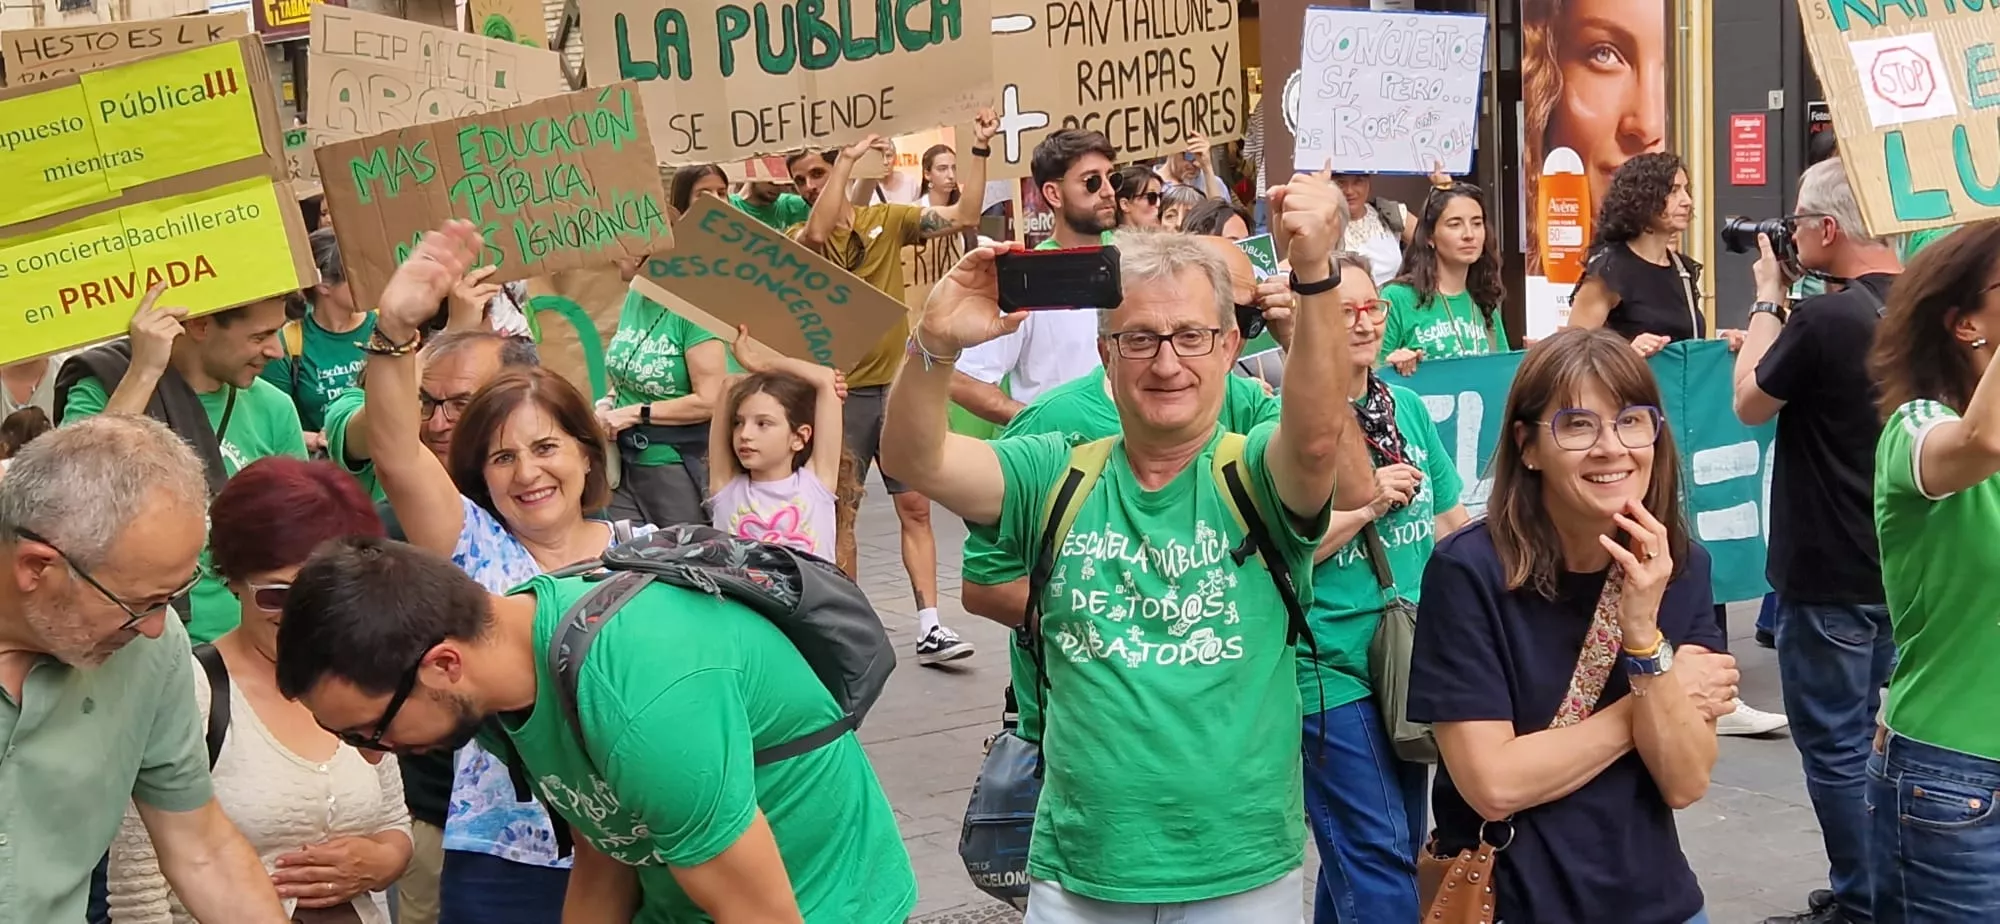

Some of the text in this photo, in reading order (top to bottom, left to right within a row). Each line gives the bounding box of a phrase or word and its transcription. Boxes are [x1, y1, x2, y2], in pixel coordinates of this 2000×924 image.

[128, 28, 163, 50] ES
[320, 15, 408, 60] CEIP
[615, 8, 693, 82] LA
[1046, 0, 1233, 47] PANTALLONES
[1306, 15, 1482, 72] CONCIERTOS
[1077, 42, 1230, 106] RAMPAS Y
[1880, 59, 1924, 94] STOP
[100, 84, 207, 124] Pública
[350, 87, 634, 199] MÁS EDUCACIÓN
[669, 113, 708, 154] SE
[1299, 129, 1323, 150] DE
[1331, 105, 1411, 159] ROCK
[1411, 122, 1474, 172] ROLL
[43, 144, 145, 183] mientras
[450, 164, 600, 222] PÚBLICA,
[126, 201, 260, 248] Bachillerato
[514, 194, 666, 265] IGNORANCIA
[699, 209, 854, 306] ESTAMOS
[25, 254, 218, 325] en PRIVADA
[1062, 529, 1230, 578] ESCUELA PÚBLICA
[1071, 589, 1225, 623] DE TOD@S
[1061, 633, 1244, 666] PARA TOD@S
